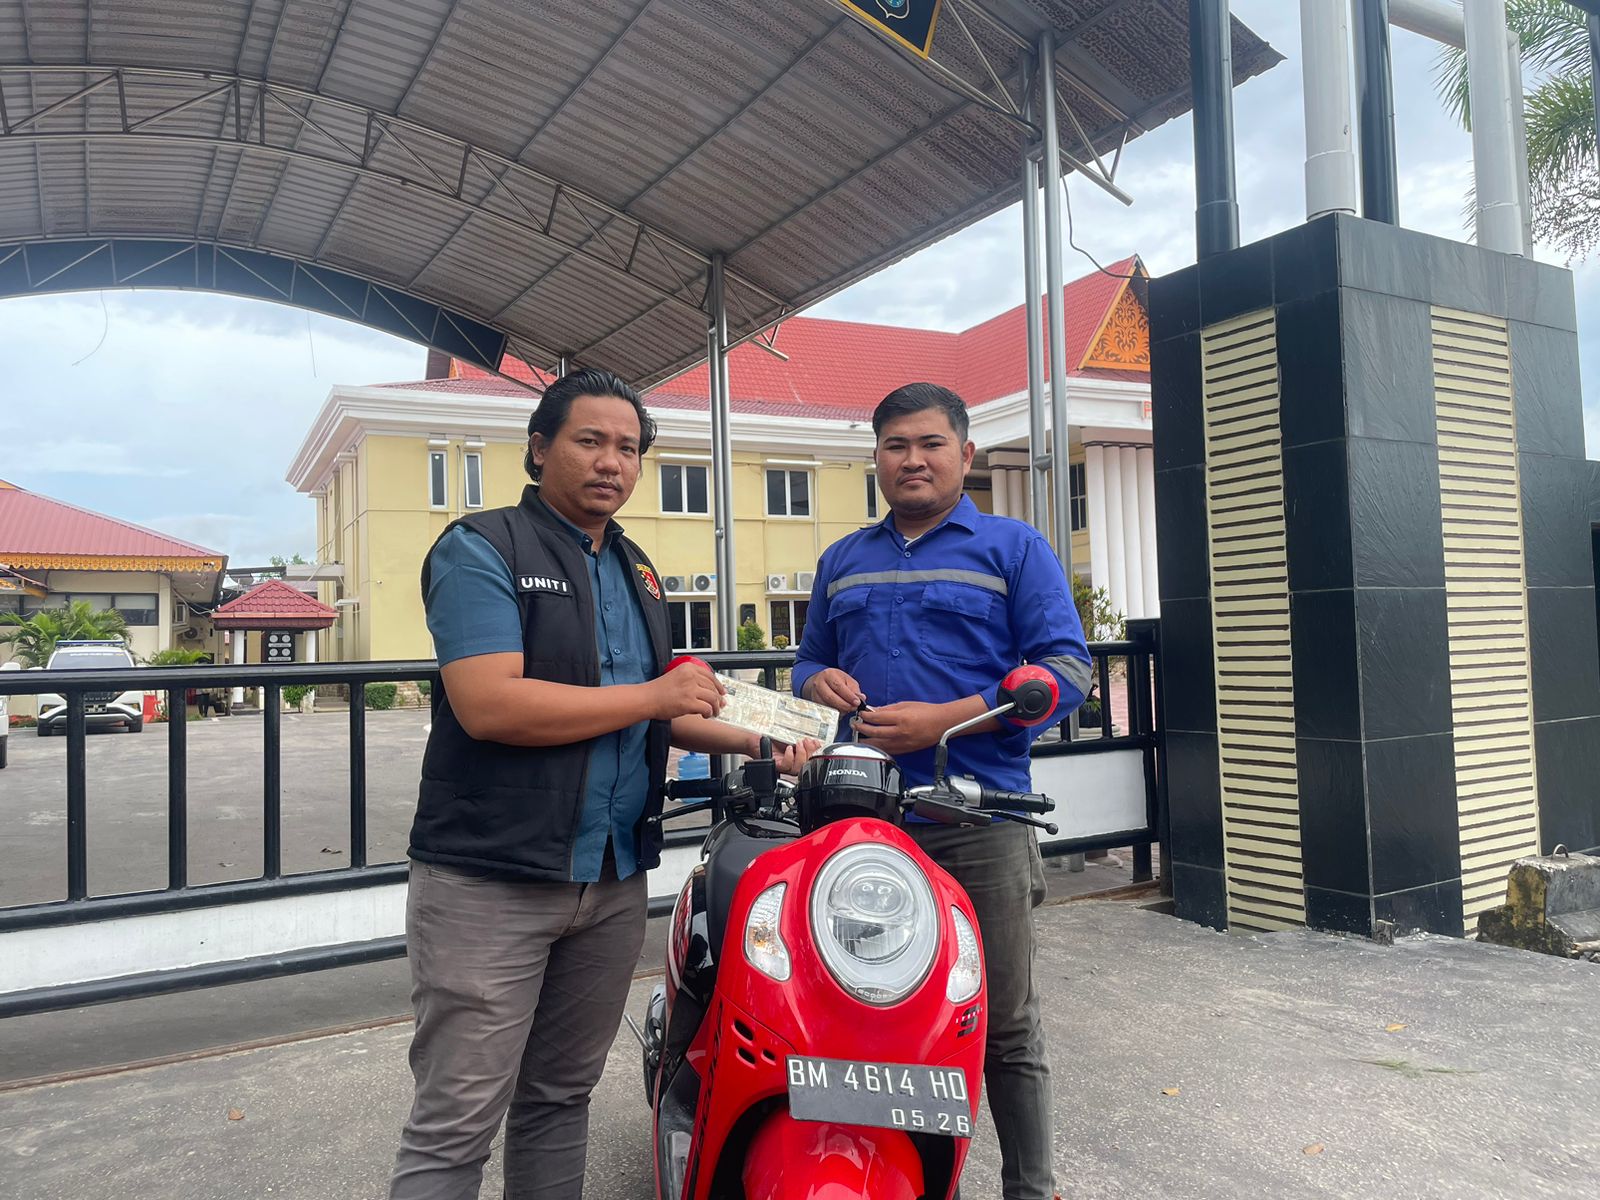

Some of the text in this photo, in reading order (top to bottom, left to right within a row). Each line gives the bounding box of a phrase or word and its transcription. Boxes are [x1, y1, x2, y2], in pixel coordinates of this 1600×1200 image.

[828, 768, 868, 778] HONDA
[788, 1059, 828, 1088] BM
[844, 1064, 915, 1096] 4614
[937, 1112, 970, 1133] 26
